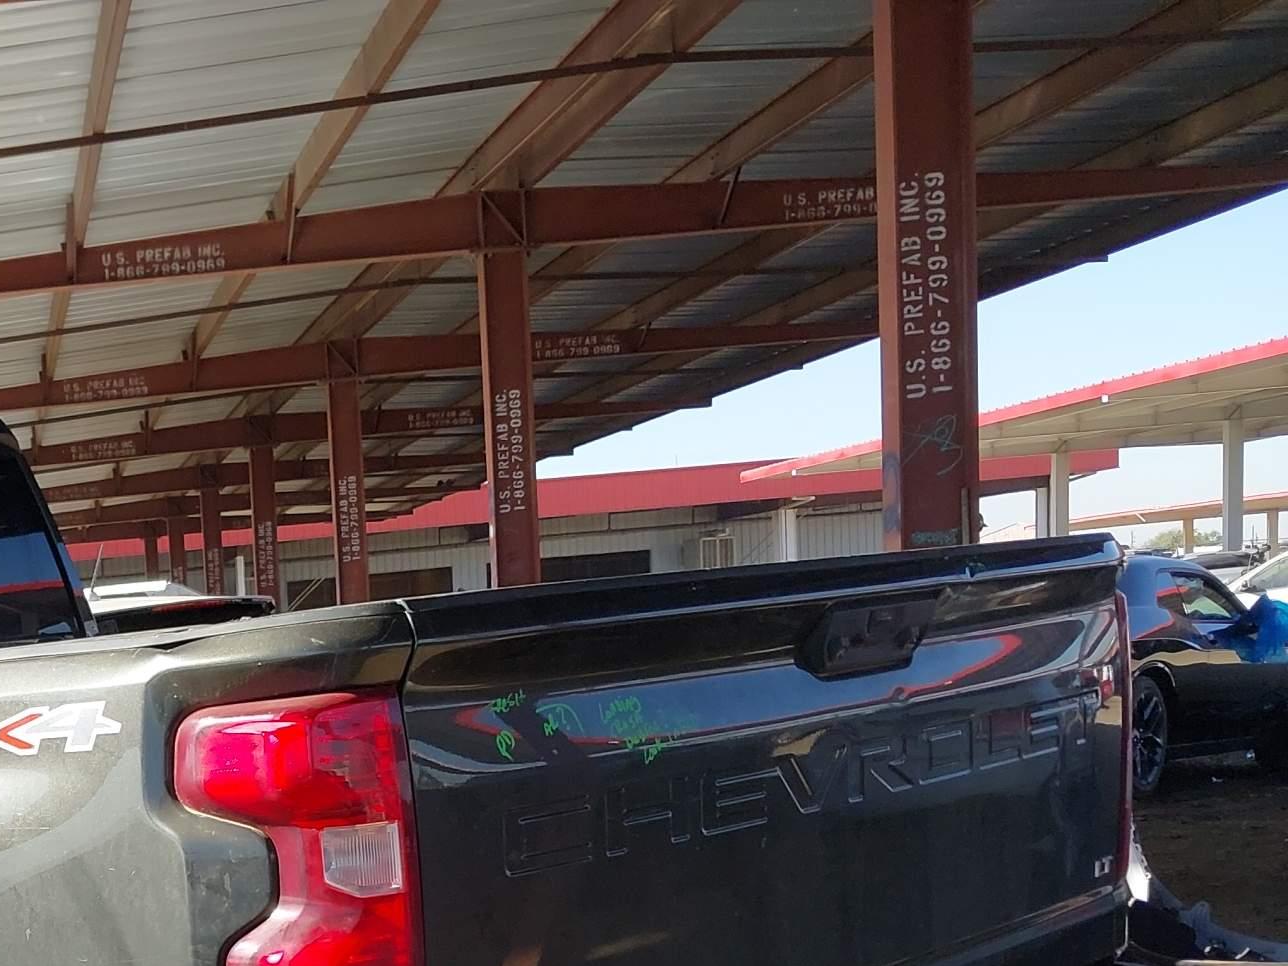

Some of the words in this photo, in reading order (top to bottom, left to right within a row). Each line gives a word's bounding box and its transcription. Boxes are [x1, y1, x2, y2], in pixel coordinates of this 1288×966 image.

[818, 187, 874, 203] PREFAB
[899, 172, 920, 222] INC.
[136, 245, 192, 263] PREFAB
[901, 236, 924, 336] PREFAB
[924, 171, 953, 394] 1-866-799-0969
[905, 349, 927, 399] U.S.
[495, 389, 508, 417] INC.
[496, 423, 510, 479] PREFAB
[509, 389, 526, 511] 1-866-799-0969
[499, 486, 511, 513] U.S.
[503, 686, 1101, 877] CHEVROLET
